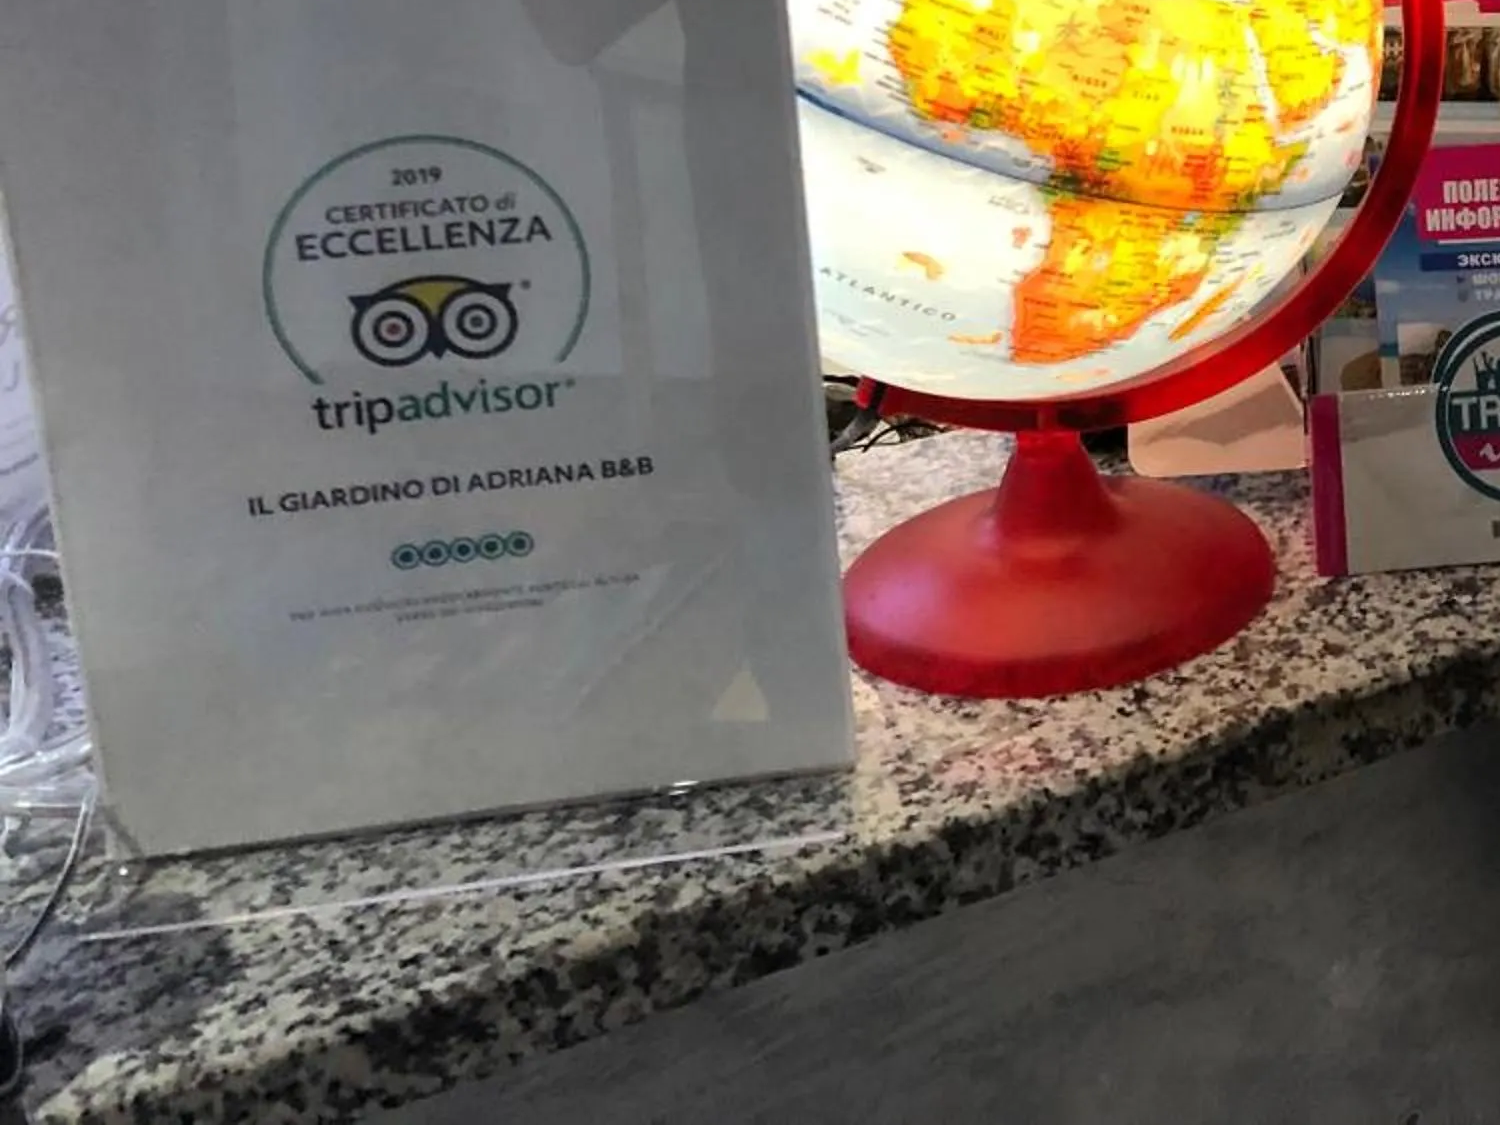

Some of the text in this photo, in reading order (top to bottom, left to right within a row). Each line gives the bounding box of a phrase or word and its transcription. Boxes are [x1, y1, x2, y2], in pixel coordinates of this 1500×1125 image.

[391, 166, 443, 187] 2019
[325, 192, 517, 226] CERTIFICATO di
[295, 215, 552, 263] ECCELLENZA
[820, 266, 956, 321] ATLANTICO
[312, 380, 560, 435] tripadvisor
[248, 456, 655, 517] IL GIARDINO DI ADRIANA B&B
